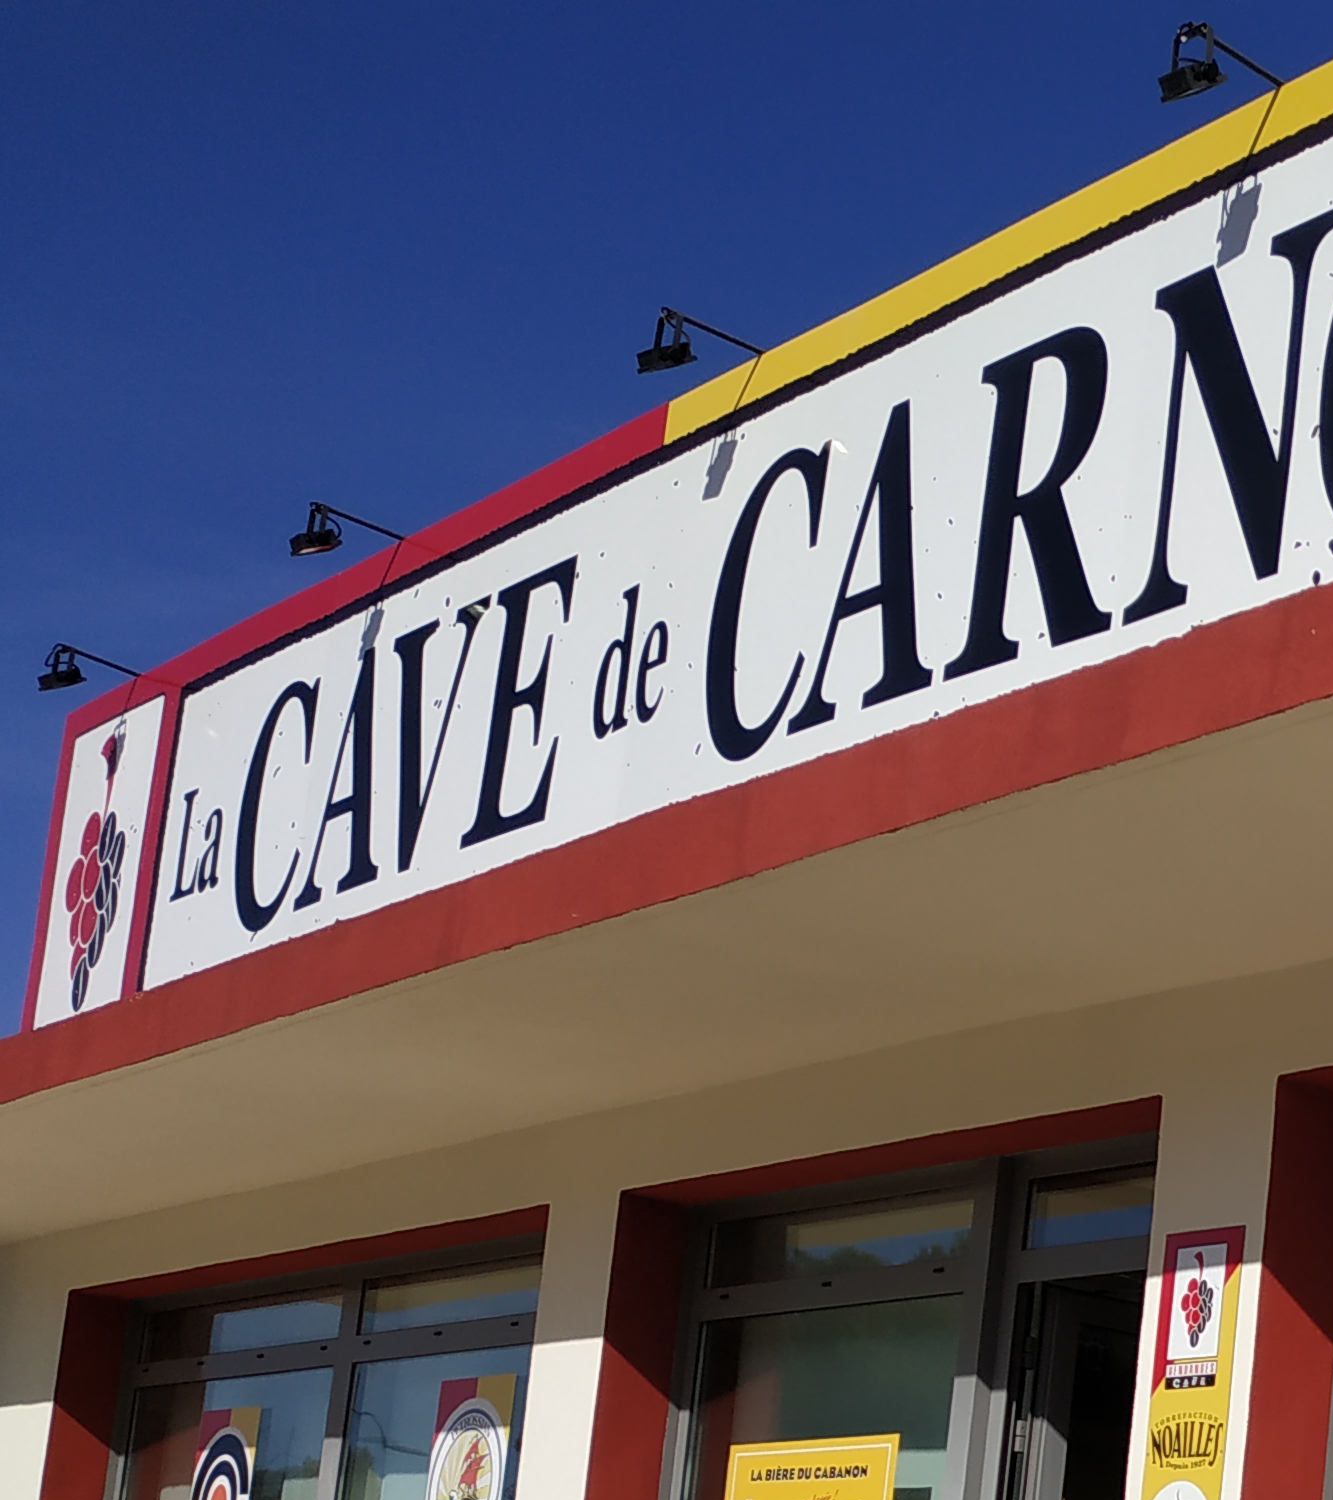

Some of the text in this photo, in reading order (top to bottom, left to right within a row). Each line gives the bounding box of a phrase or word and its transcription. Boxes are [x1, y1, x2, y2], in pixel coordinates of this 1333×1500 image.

[170, 789, 223, 903] La
[233, 554, 579, 934] CAVE
[592, 584, 669, 741] de
[1150, 1421, 1224, 1469] NOAILLES
[750, 1465, 869, 1482] LA BIÈRE DU CABANON
